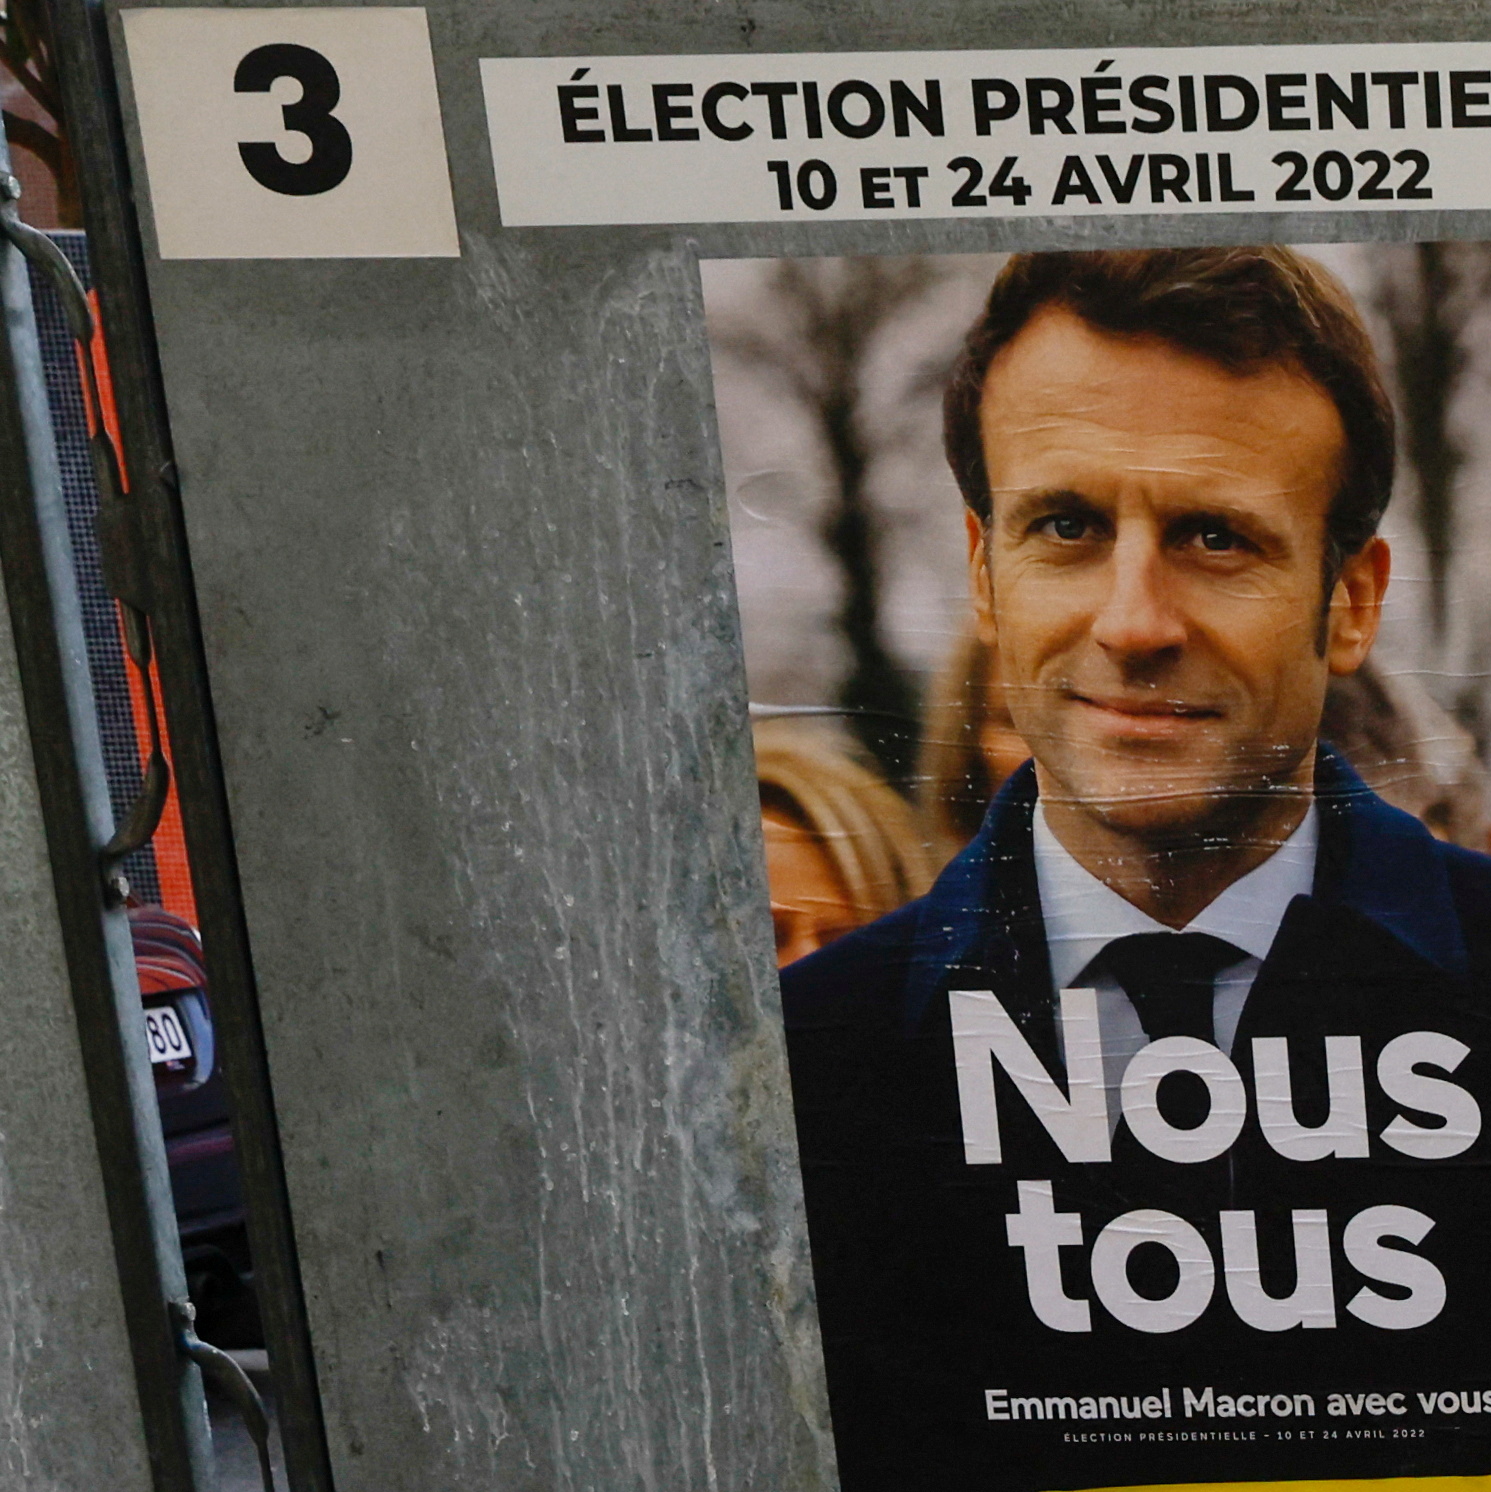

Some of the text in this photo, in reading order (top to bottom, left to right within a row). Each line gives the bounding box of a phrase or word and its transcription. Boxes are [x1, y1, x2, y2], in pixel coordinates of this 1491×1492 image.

[233, 43, 353, 197] 3
[556, 67, 945, 144] ÉLECTION
[766, 148, 1433, 211] 10 ET 24 AVRIL 2022
[948, 987, 1482, 1164] Nous
[1005, 1179, 1447, 1334] tous
[984, 1387, 1172, 1421] Emmanuel
[1182, 1386, 1316, 1418] Macron
[1326, 1392, 1408, 1417] avec
[1063, 1432, 1132, 1443] ÉLECTION
[1139, 1431, 1256, 1442] PRÉSIDENTIELLE
[1277, 1430, 1292, 1441] 10
[1299, 1430, 1315, 1440] ET
[1322, 1430, 1338, 1440] 24
[1345, 1430, 1385, 1439] AVRIL
[1392, 1428, 1425, 1438] 2022
